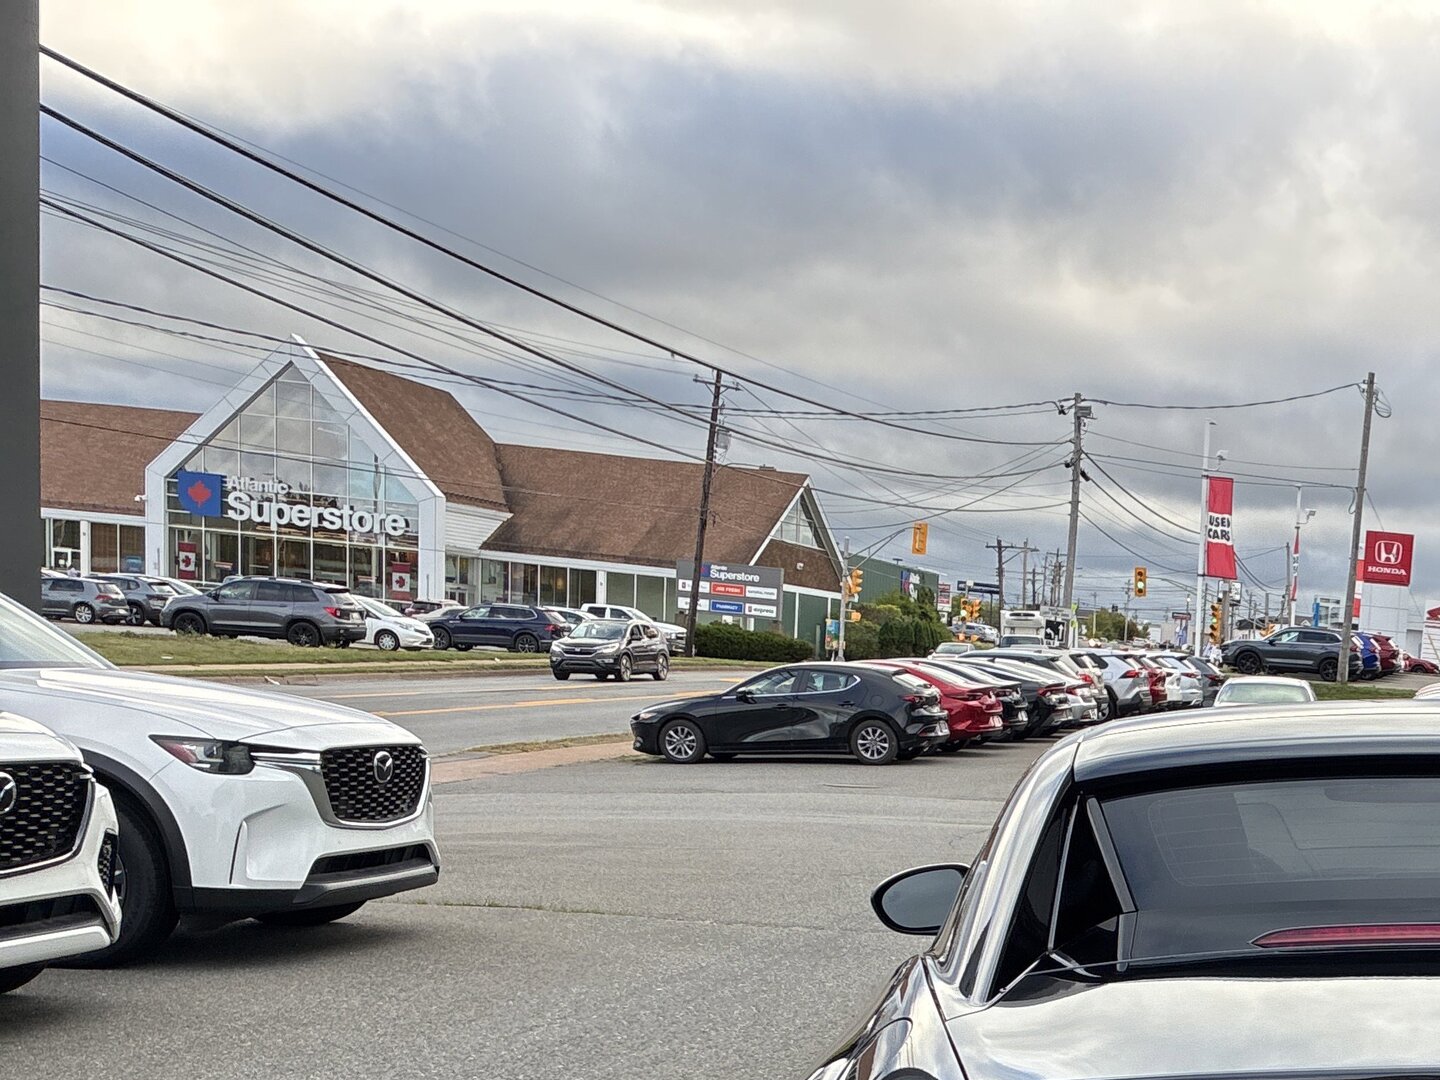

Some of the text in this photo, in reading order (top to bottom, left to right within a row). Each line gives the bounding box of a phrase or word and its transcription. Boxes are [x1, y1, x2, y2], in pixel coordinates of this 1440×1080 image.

[228, 475, 289, 494] Atlantic
[228, 491, 407, 536] Superstore
[710, 569, 760, 583] Superstore
[1367, 565, 1407, 576] HONDA
